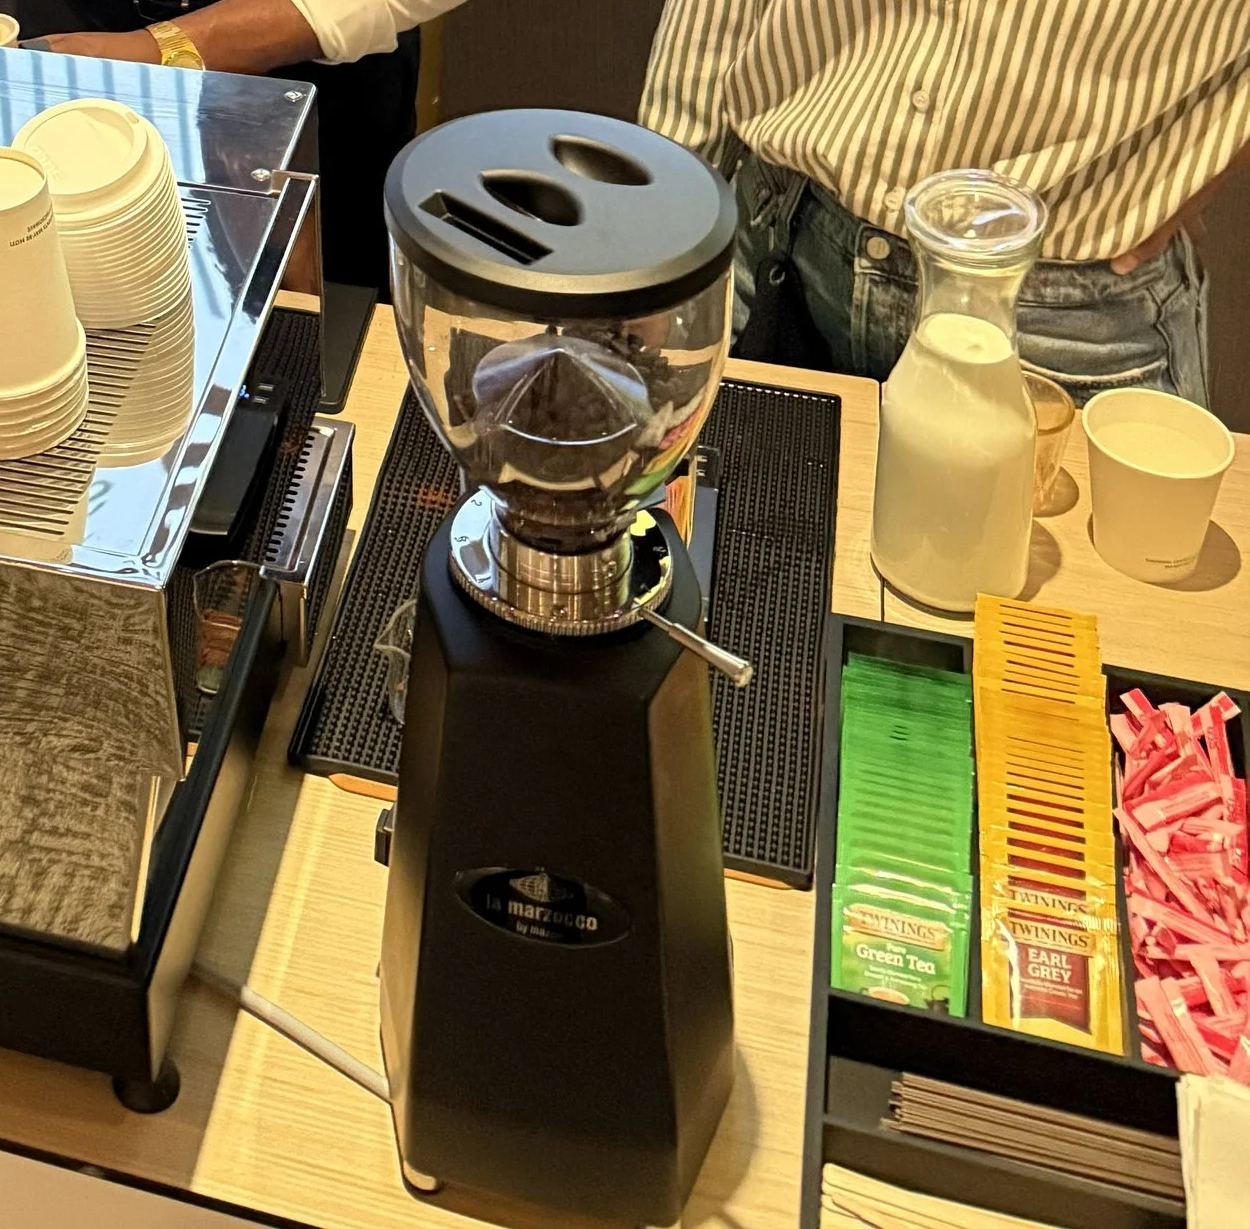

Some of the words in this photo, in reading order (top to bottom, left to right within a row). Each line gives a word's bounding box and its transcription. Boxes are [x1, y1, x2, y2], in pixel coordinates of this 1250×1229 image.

[508, 901, 598, 931] marzocco
[859, 910, 937, 940] TWININGS
[1009, 921, 1090, 948] TWININGS
[856, 944, 903, 967] Green
[906, 954, 936, 975] Tea
[1027, 947, 1073, 970] EARL
[1027, 963, 1072, 984] GREY
